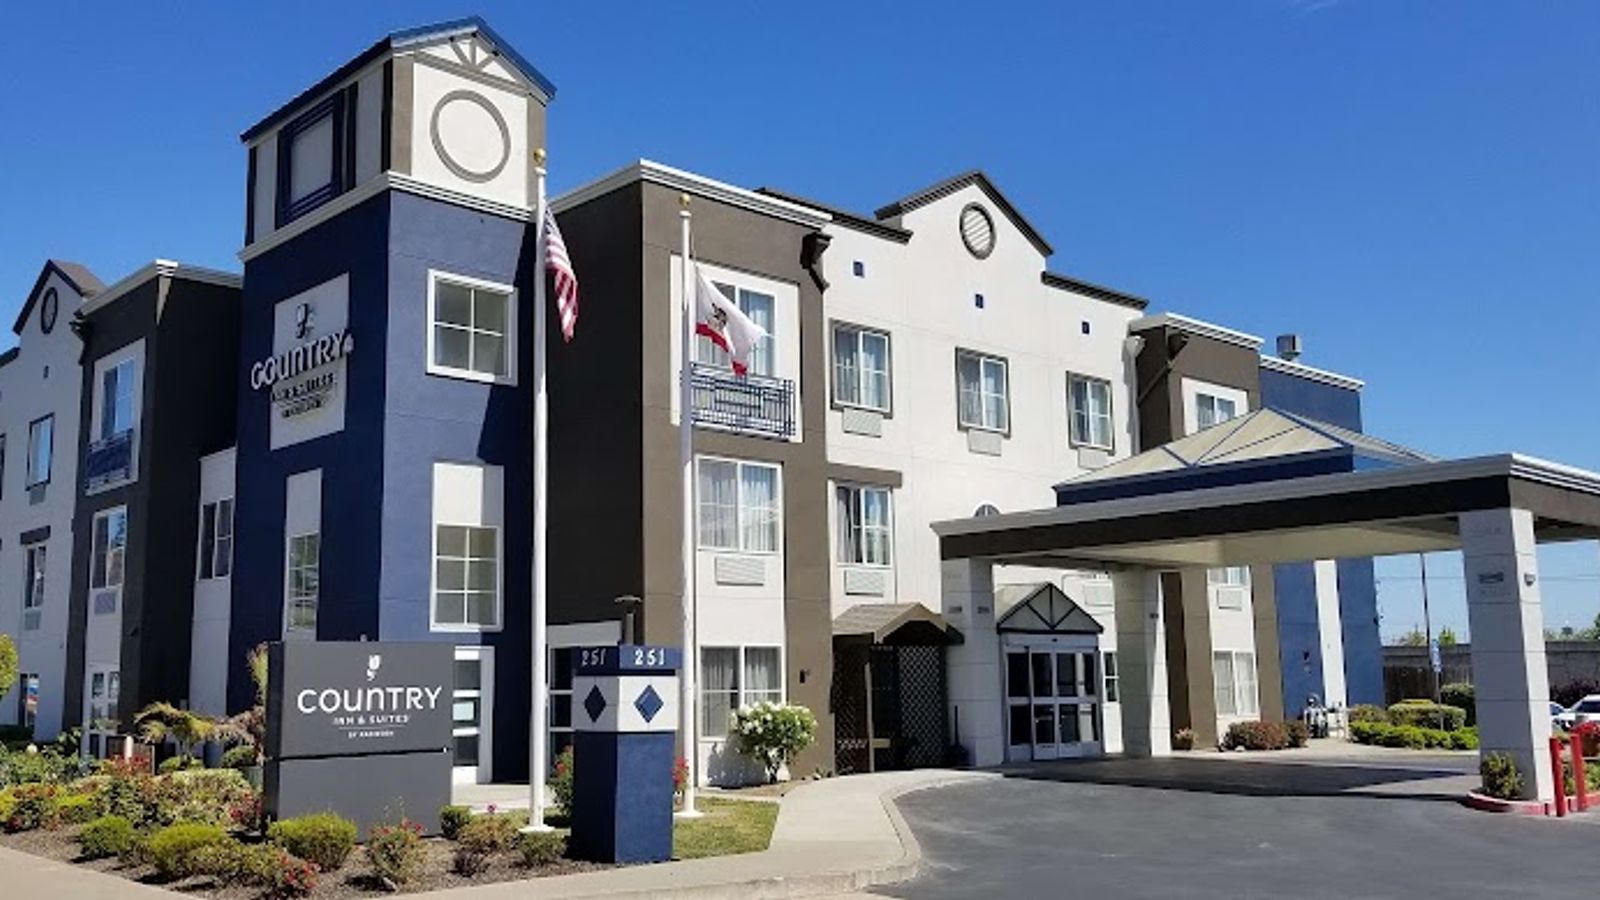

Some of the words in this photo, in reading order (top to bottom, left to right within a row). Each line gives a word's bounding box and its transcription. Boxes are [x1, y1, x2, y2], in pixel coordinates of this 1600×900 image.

[251, 328, 348, 390] COUNTRY
[581, 648, 606, 666] 251
[634, 648, 664, 665] 251
[297, 686, 442, 713] COUNTRY
